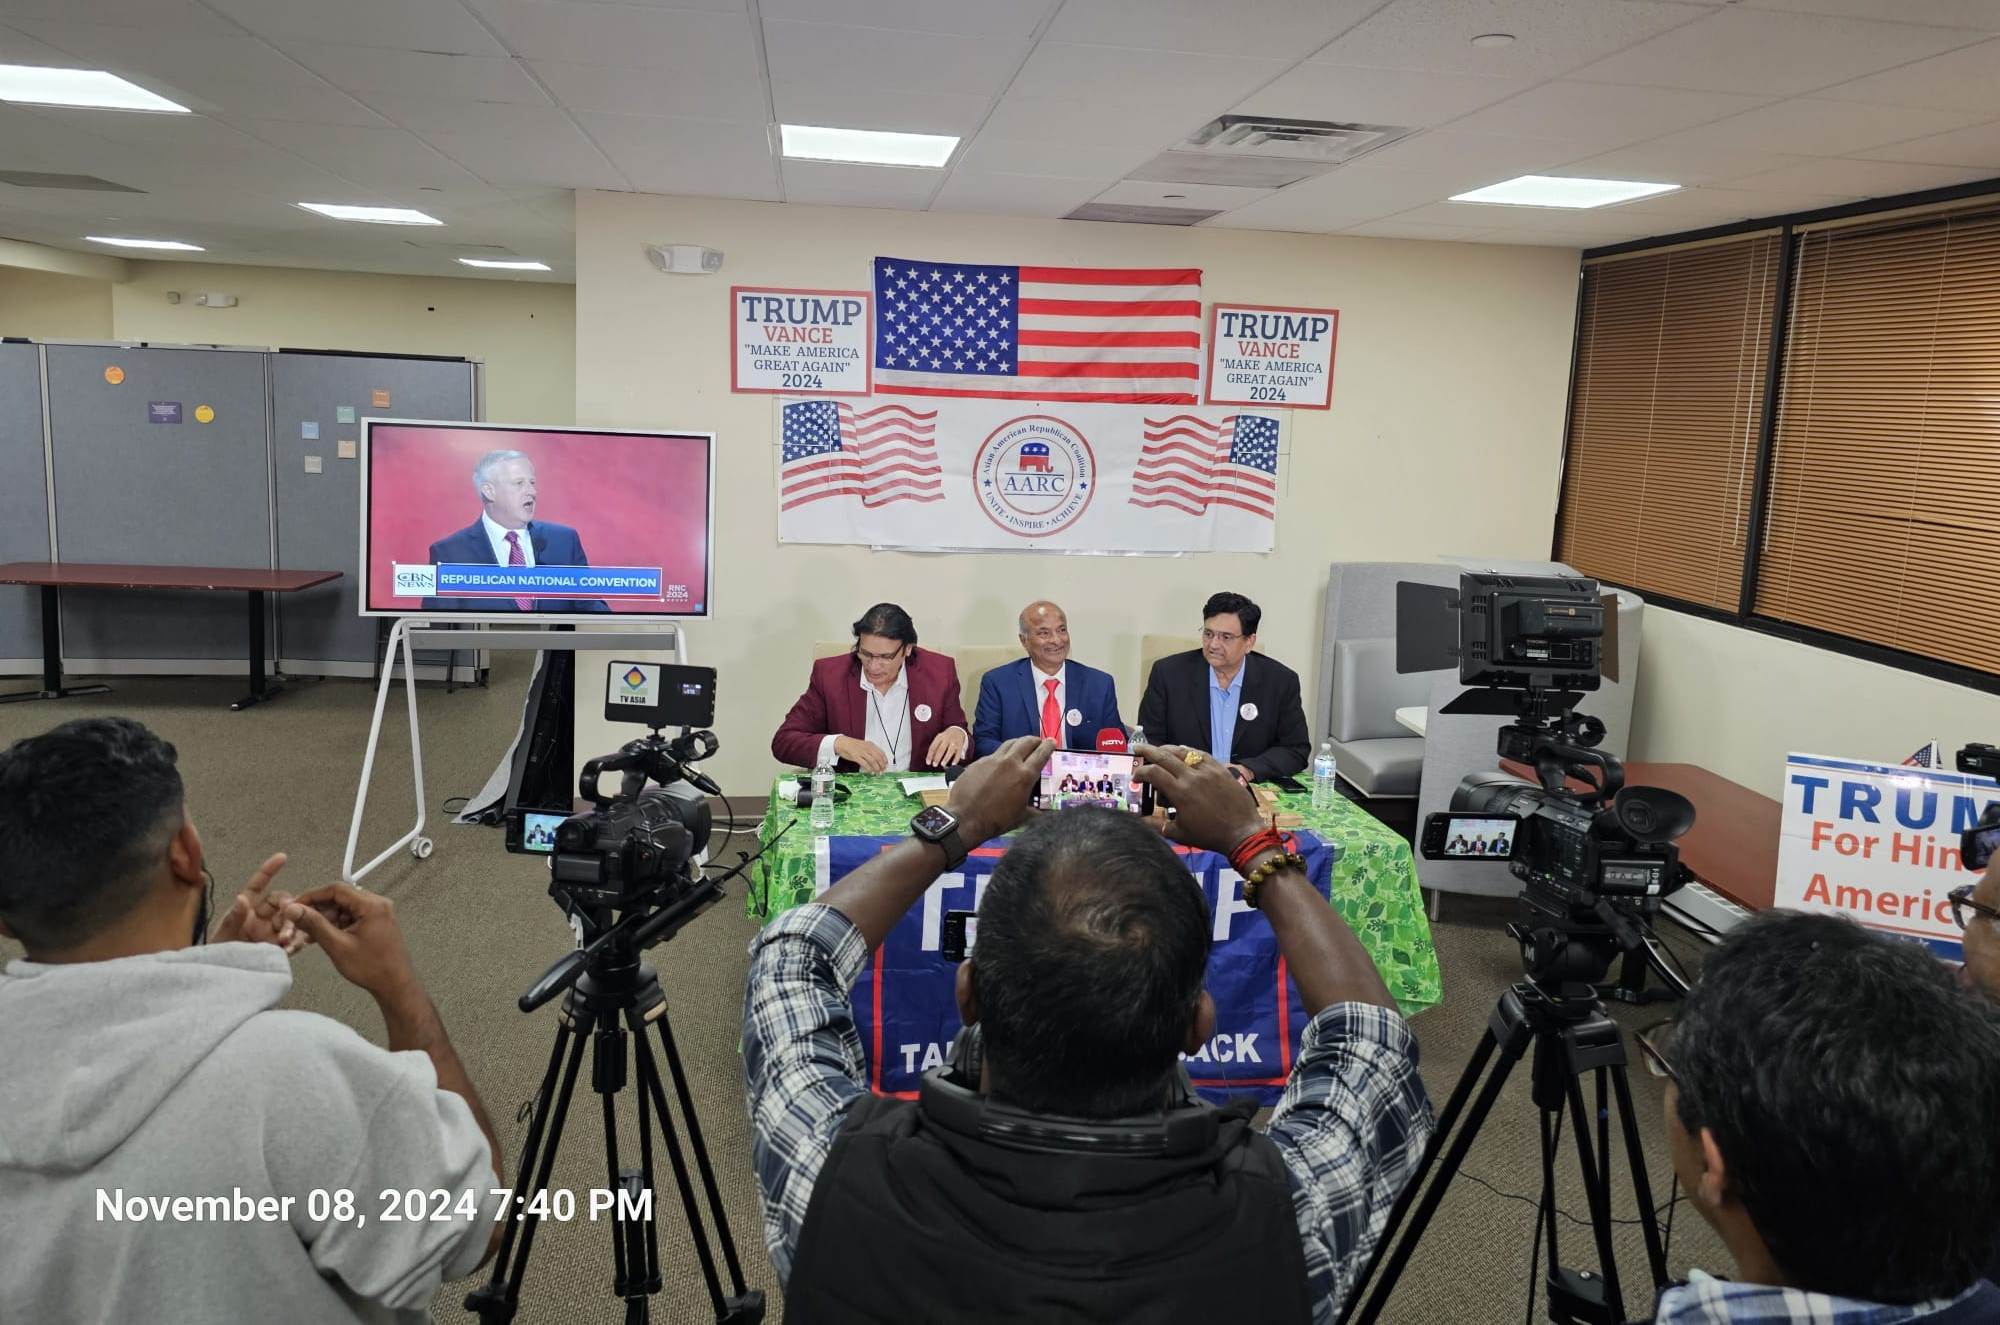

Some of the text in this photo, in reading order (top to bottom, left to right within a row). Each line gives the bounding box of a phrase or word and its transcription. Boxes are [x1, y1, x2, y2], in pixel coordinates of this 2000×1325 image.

[741, 295, 862, 326] TRUMP
[763, 325, 833, 344] VANCE
[1221, 312, 1329, 342] TRUMP
[745, 344, 860, 359] "MAKE AMERICA
[1237, 340, 1301, 359] VANCE
[753, 359, 851, 373] GREAT AGAIN"
[1220, 358, 1323, 374] "MAKE AMERICA
[782, 373, 823, 389] 2024
[1226, 373, 1314, 387] GREAT AGAIN"
[1249, 386, 1287, 401] 2024
[983, 424, 1086, 478] Asian American Republican Coalition
[1004, 476, 1065, 492] AARC
[985, 492, 1083, 529] UNITE INSPIRE ACHIEVE
[397, 572, 433, 582] CBN
[398, 581, 435, 589] NEWS
[440, 573, 657, 588] REPUBLICAN NATIONAL CONVENTION
[666, 591, 689, 599] 2024
[668, 584, 687, 592] RNC
[630, 696, 646, 704] ASIA
[1791, 774, 1999, 835] TRUM
[1811, 821, 1990, 875] For Hin
[1802, 873, 1954, 924] Americ
